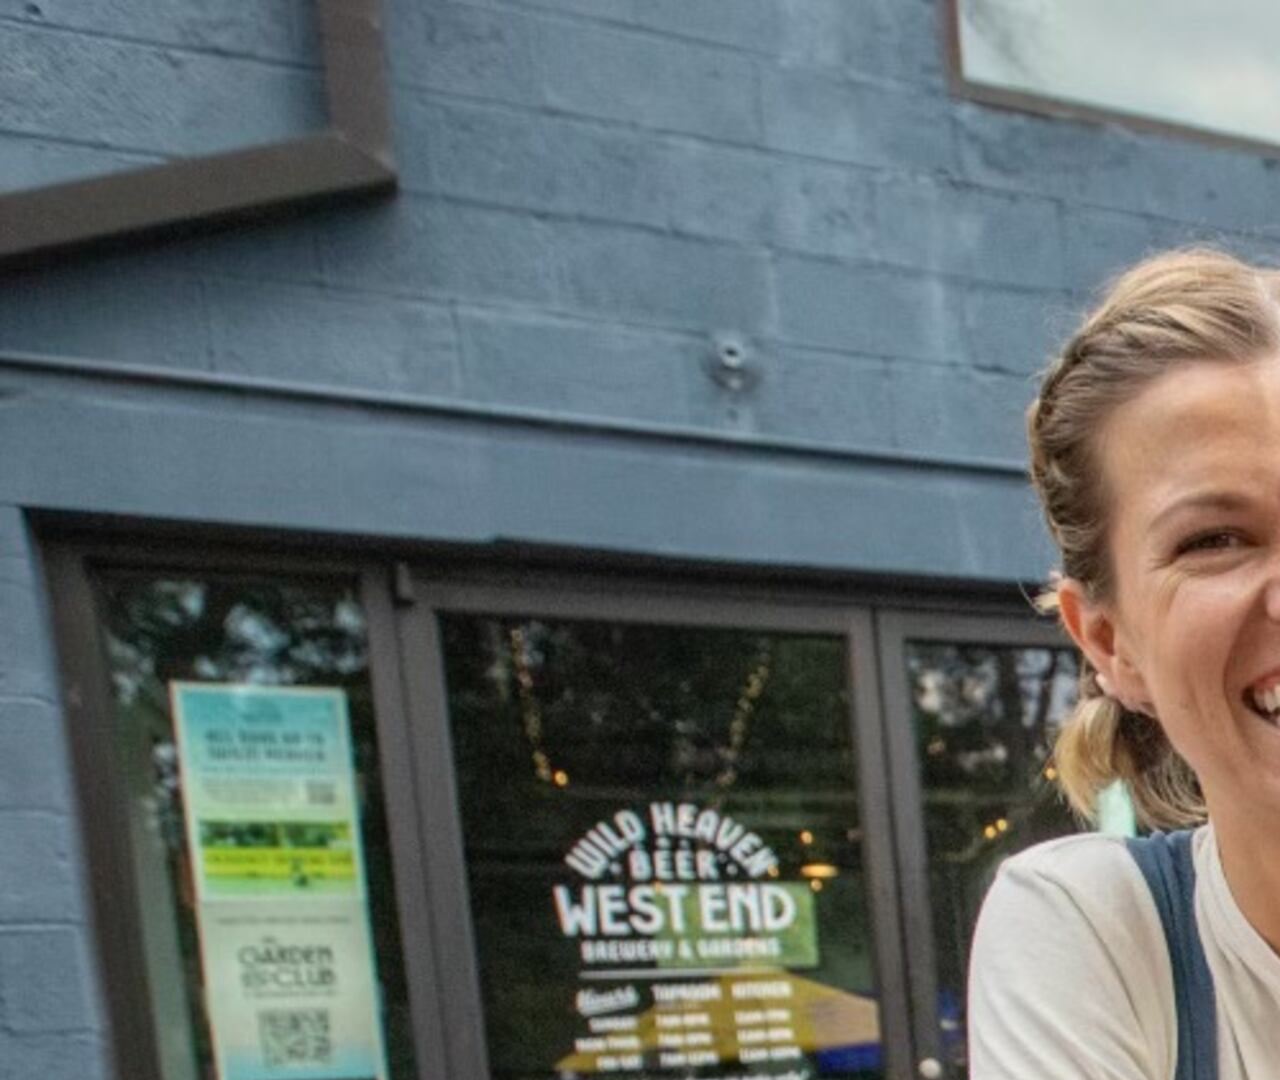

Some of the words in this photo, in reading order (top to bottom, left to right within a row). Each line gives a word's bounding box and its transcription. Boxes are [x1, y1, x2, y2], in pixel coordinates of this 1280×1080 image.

[563, 809, 646, 880] WILD
[649, 801, 780, 878] HEAVEN
[627, 847, 720, 881] BEER
[552, 882, 688, 937] WEST
[698, 882, 797, 933] END
[236, 944, 335, 967] GARDEN
[580, 939, 674, 963] BREWERY
[696, 936, 783, 959] GARDENS
[273, 965, 337, 987] CLUB
